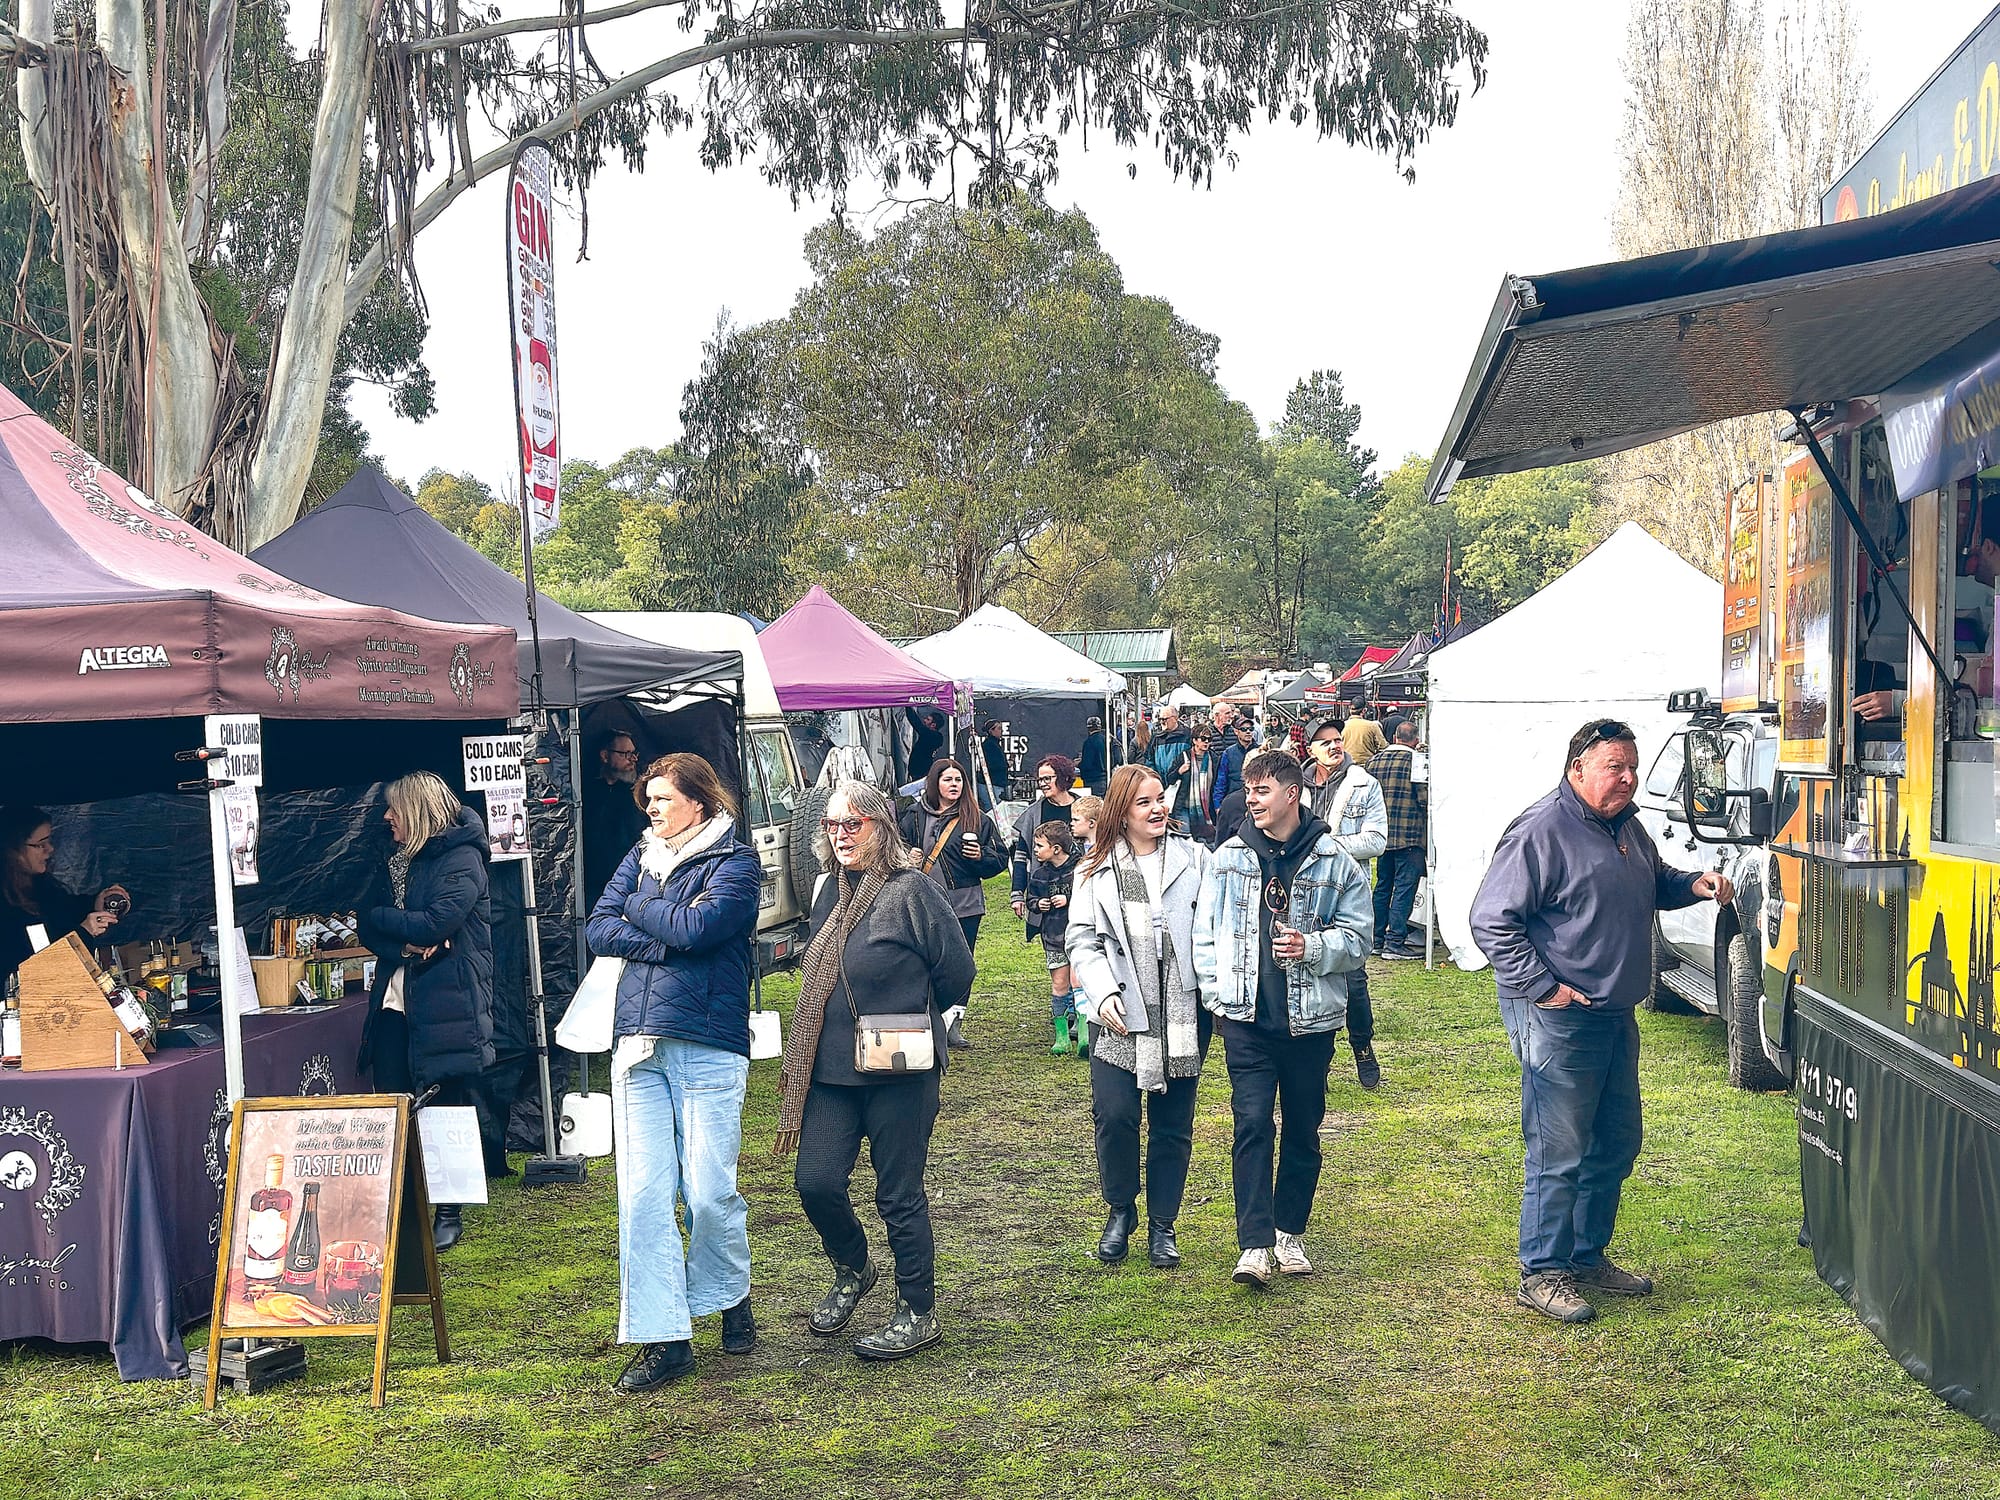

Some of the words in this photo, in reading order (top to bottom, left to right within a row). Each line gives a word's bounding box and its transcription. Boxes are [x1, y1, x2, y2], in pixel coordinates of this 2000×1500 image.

[1977, 61, 2000, 176] D
[514, 181, 551, 267] GIN
[365, 635, 389, 652] Award
[390, 637, 419, 658] winning
[78, 645, 169, 675] ALTEGRA
[356, 656, 382, 677] Spirits
[384, 658, 398, 673] and
[399, 659, 428, 678] Liqueurs
[358, 687, 401, 706] Mornington
[402, 688, 435, 704] Peninsula
[220, 723, 241, 745] COLD
[242, 723, 260, 745] CANS
[465, 742, 493, 759] COLD
[496, 741, 522, 758] CANS
[225, 754, 241, 778] $10
[242, 753, 259, 776] EACH
[470, 765, 492, 783] $10
[495, 764, 521, 781] EACH
[229, 807, 244, 824] $12
[491, 804, 507, 818] $12
[297, 1118, 347, 1135] Mulled
[350, 1117, 388, 1134] Wine
[294, 1154, 342, 1177] TASTE
[344, 1154, 383, 1176] NOW
[0, 1243, 77, 1281] iginal
